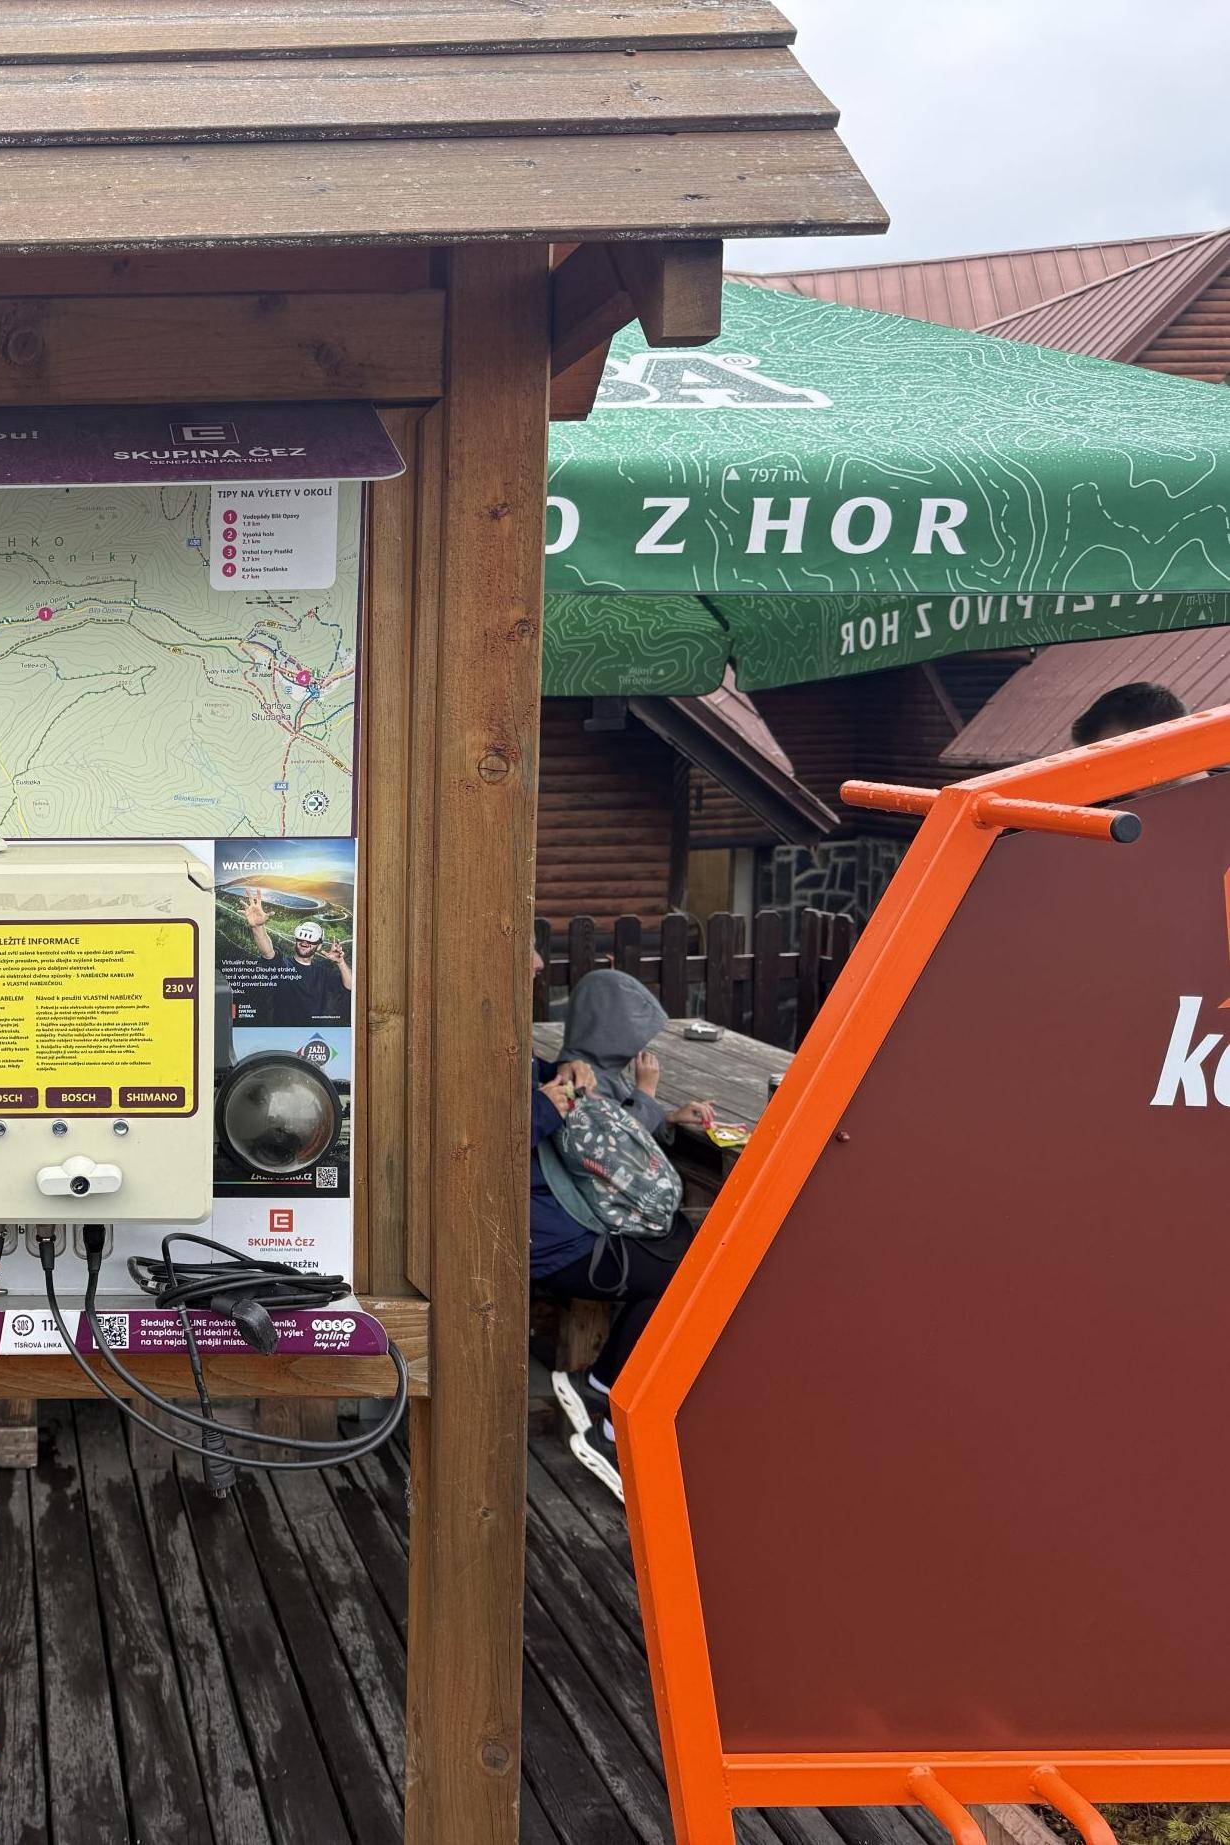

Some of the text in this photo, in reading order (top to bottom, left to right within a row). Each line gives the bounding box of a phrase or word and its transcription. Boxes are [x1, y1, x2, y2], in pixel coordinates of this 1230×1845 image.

[113, 444, 308, 461] SKUPINA ČEZ
[749, 467, 780, 483] 797
[217, 485, 333, 499] TIPY NA VÝLETY V OKOLÍ
[634, 497, 692, 556] Z
[744, 496, 969, 556] HOR
[222, 861, 284, 871] WATERTOUR
[28, 937, 80, 945] INFORMACE
[165, 984, 195, 993] 230 V
[82, 993, 109, 1001] VLASTNÍ
[1148, 995, 1230, 1108] k
[61, 1093, 96, 1102] BOSCH
[126, 1093, 178, 1102] SHIMANO
[247, 1236, 316, 1247] SKUPINA ČEZ
[283, 1328, 304, 1338] výlet
[315, 1331, 351, 1341] online
[13, 1340, 63, 1349] TÍSŇOVÁ LINKA
